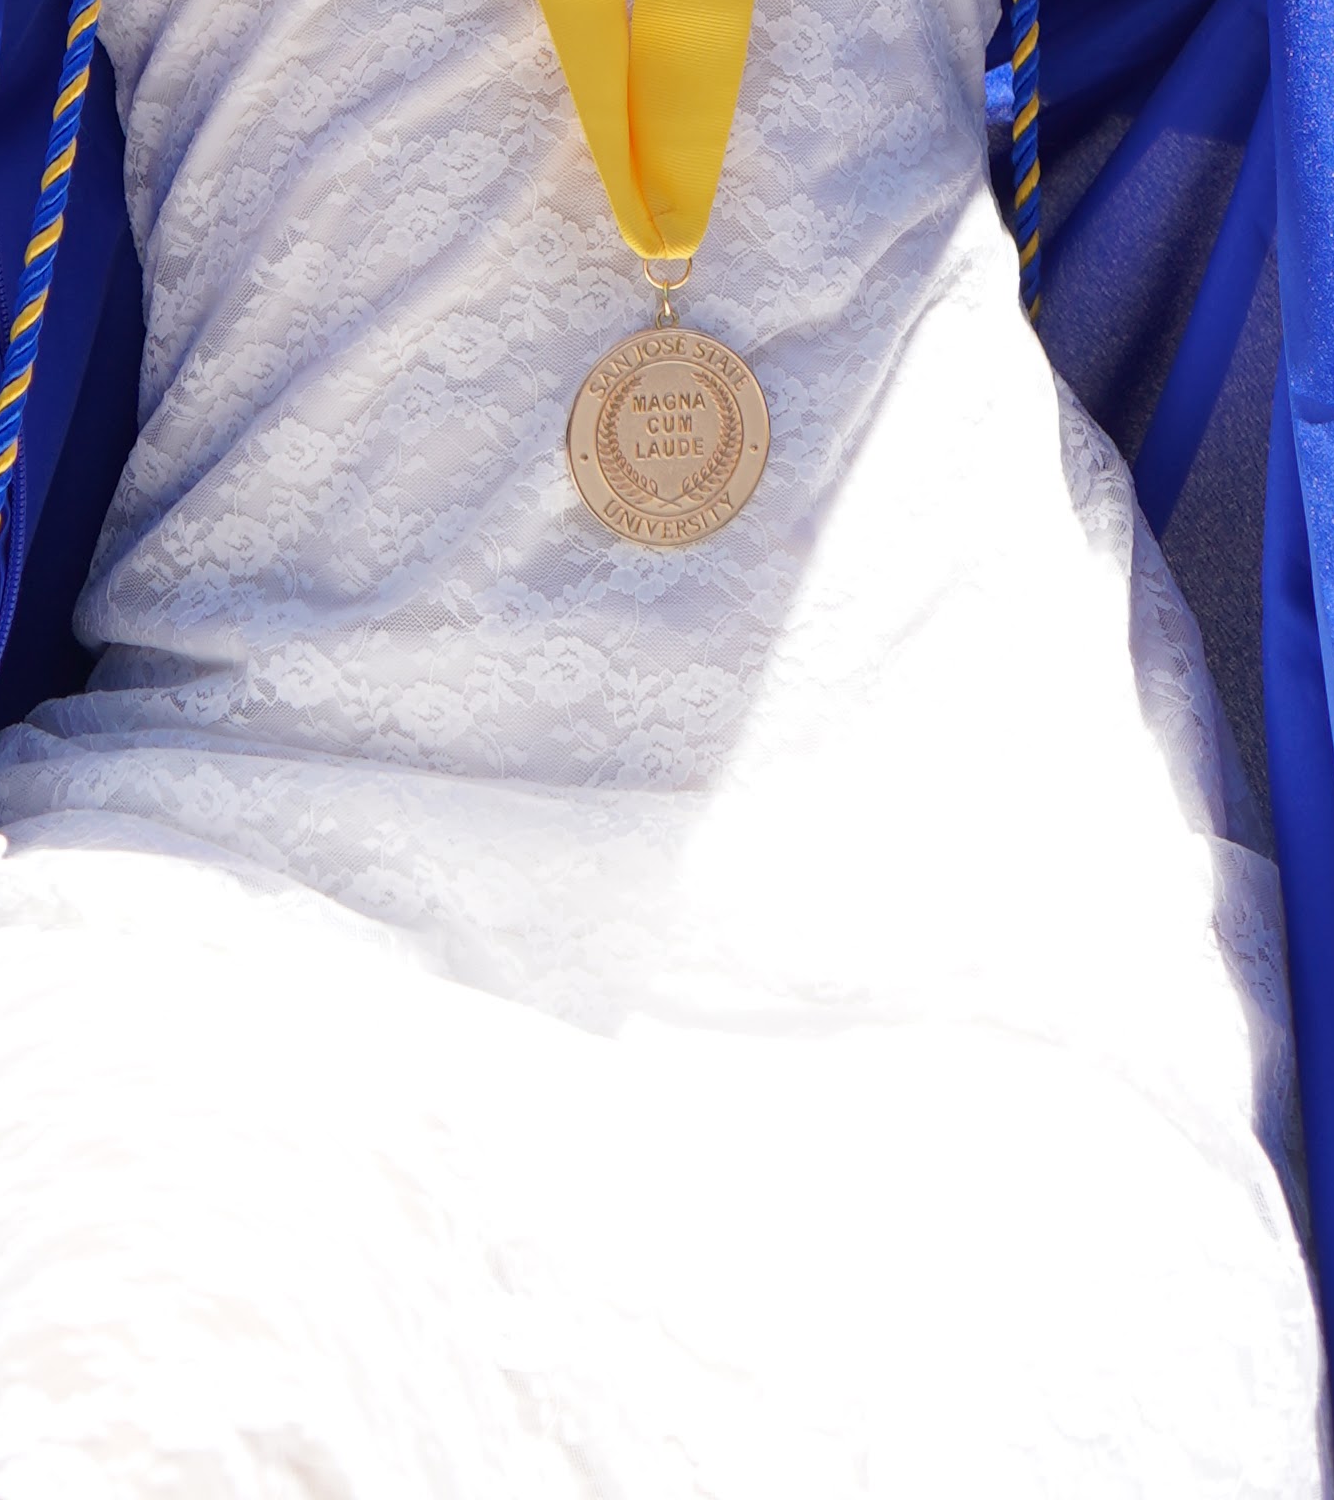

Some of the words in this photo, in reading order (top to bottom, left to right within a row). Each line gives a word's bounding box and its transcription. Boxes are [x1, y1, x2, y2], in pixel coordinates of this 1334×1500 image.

[589, 353, 633, 401] SAN
[692, 341, 750, 393] STATE
[632, 393, 705, 413] MAGNA
[646, 414, 692, 436] CUM
[635, 438, 704, 460] LAUDE
[603, 491, 734, 539] UNIVERSITY
